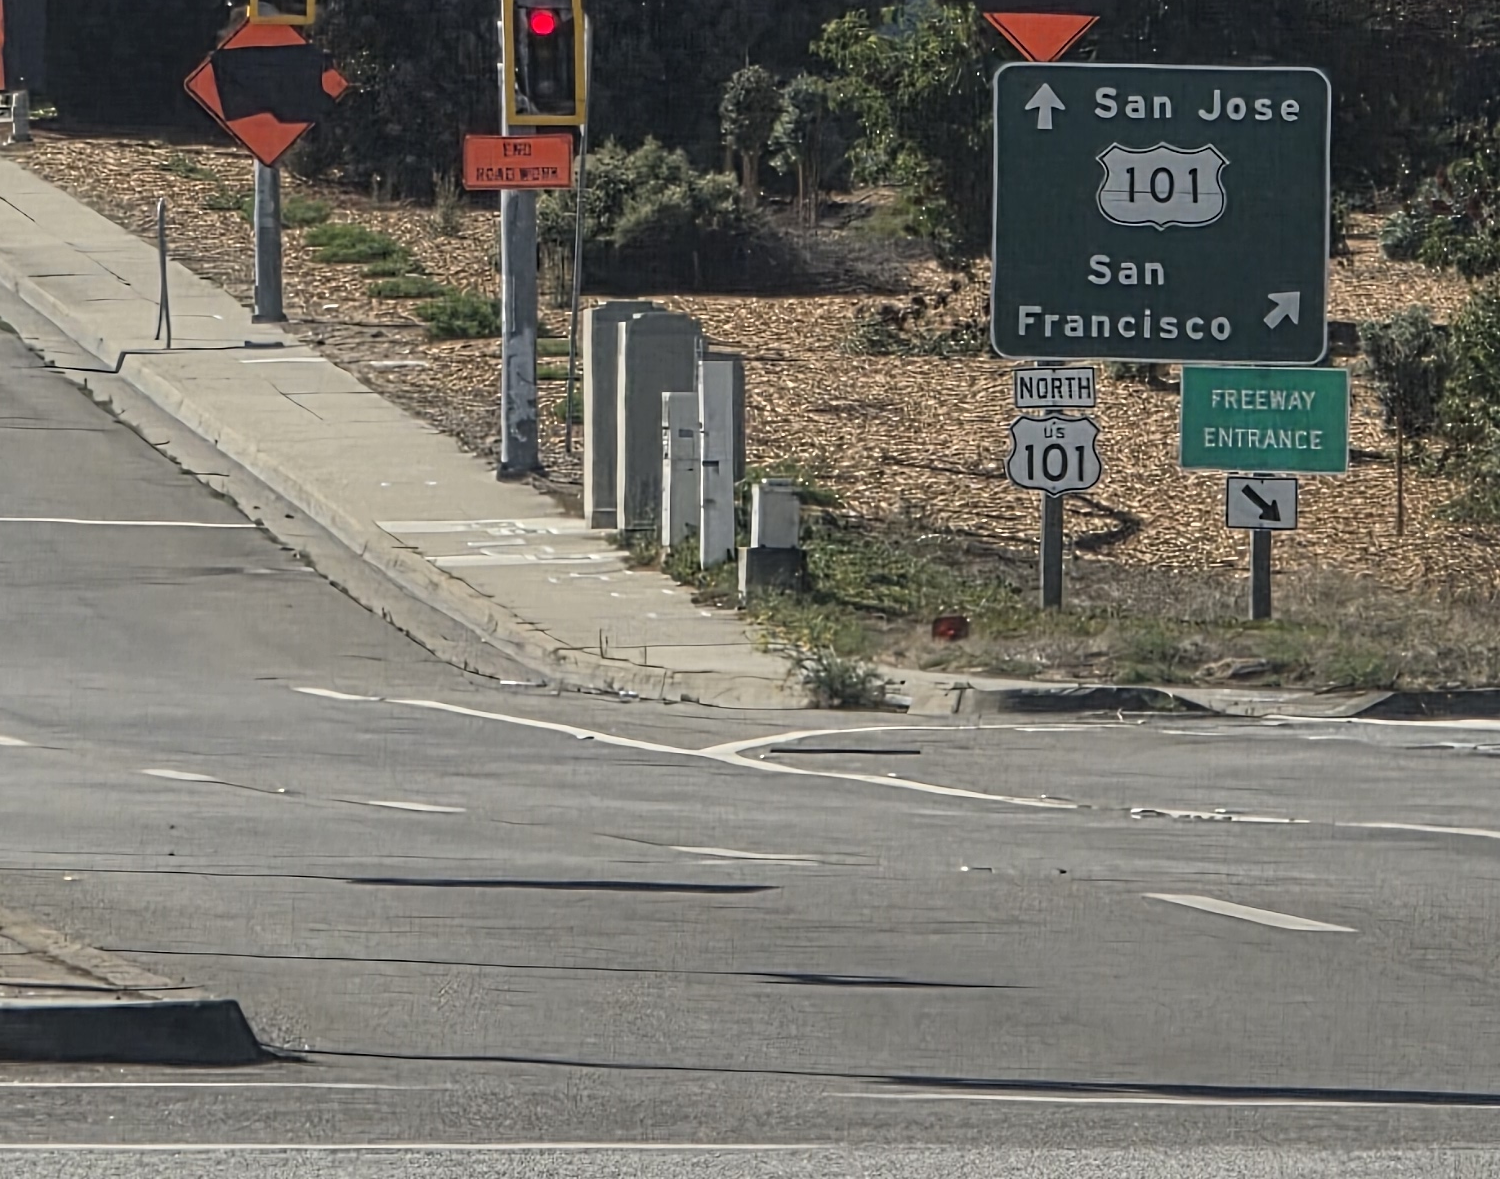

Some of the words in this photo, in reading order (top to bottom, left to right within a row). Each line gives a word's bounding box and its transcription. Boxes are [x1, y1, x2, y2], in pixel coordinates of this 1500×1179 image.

[1095, 87, 1172, 119] San
[1198, 89, 1300, 121] Jose
[503, 142, 532, 157] END
[476, 167, 515, 181] ROAD
[519, 166, 558, 181] WORK
[1126, 167, 1198, 203] 101
[1088, 254, 1165, 286] San
[1018, 305, 1231, 341] Francisco
[1019, 376, 1092, 400] NORTH
[1211, 389, 1316, 411] FREEWAY
[1044, 426, 1066, 439] US
[1203, 427, 1324, 450] ENTRANCE
[1025, 443, 1085, 482] 101
